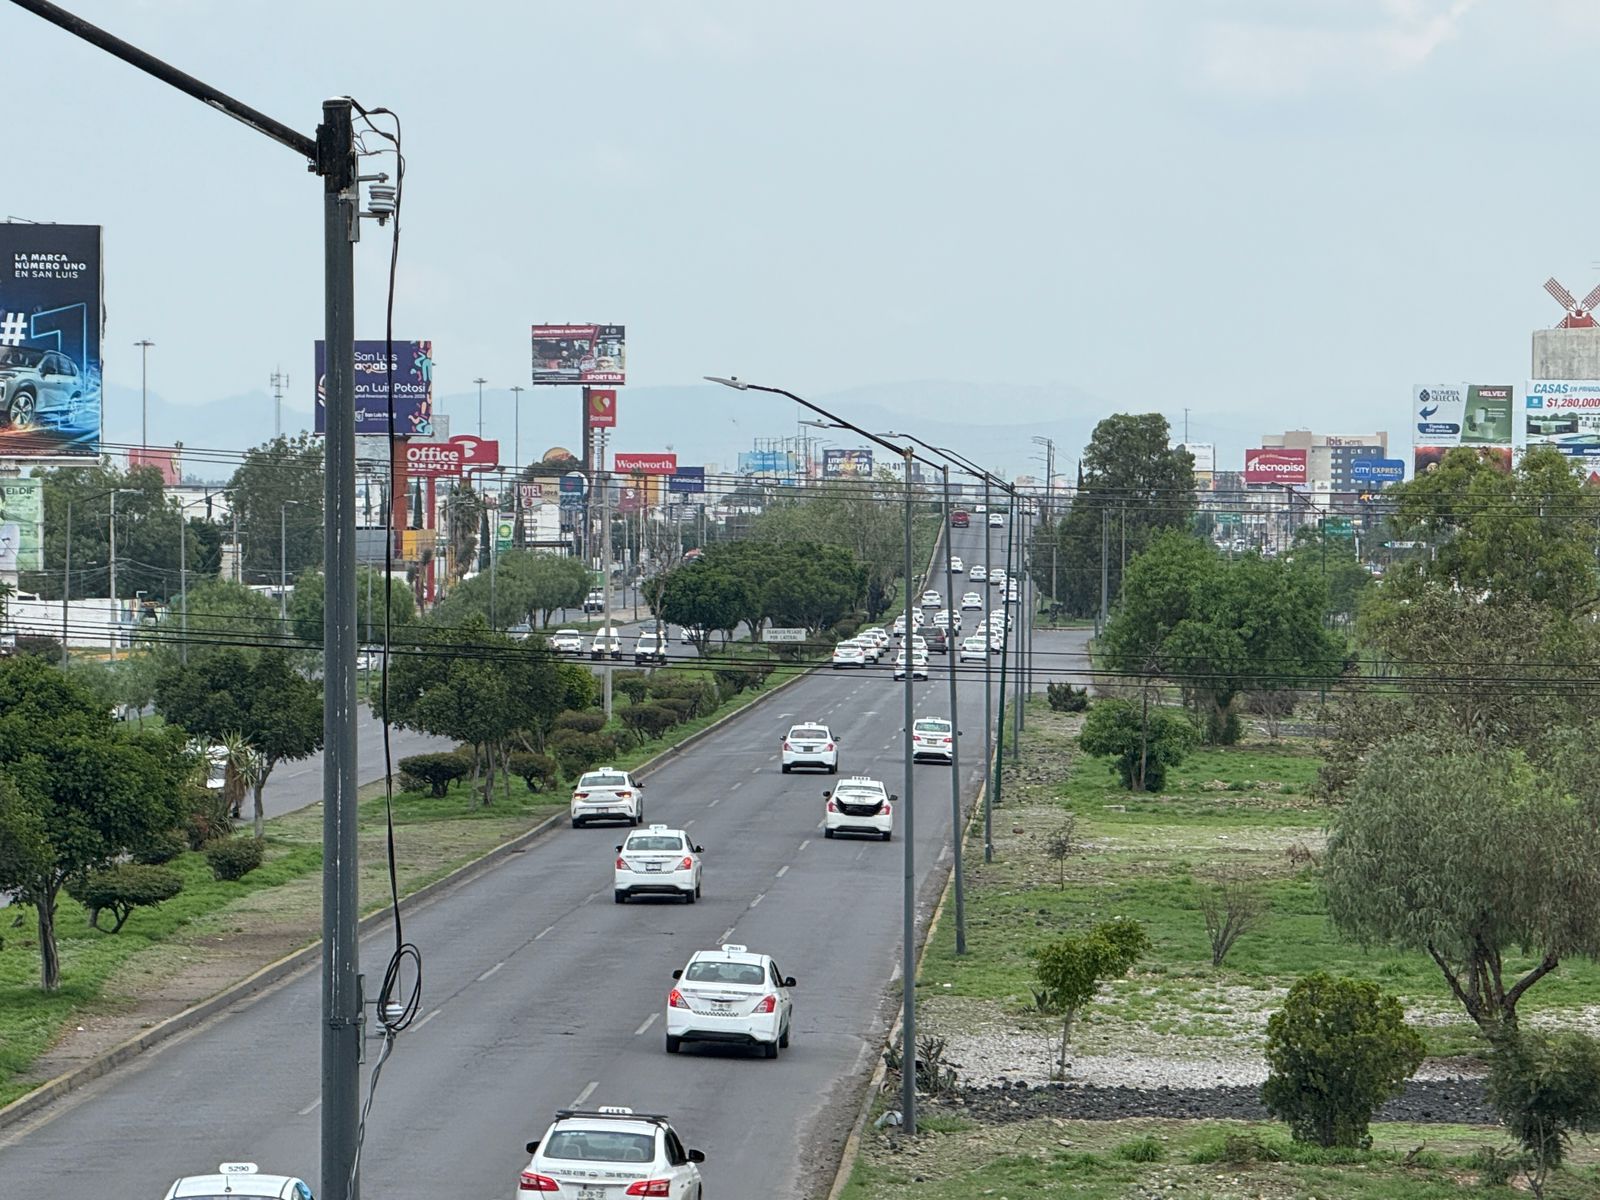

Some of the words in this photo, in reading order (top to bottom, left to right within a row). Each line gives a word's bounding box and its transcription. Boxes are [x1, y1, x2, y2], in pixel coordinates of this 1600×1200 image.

[15, 261, 60, 269] NÚMERO
[354, 352, 375, 361] San
[376, 352, 398, 361] Lus
[1533, 384, 1569, 394] CASAS
[1326, 436, 1343, 446] ibis
[406, 447, 459, 461] Office
[616, 459, 673, 469] Woolworth
[1255, 461, 1306, 474] tecnopiso
[1354, 466, 1370, 474] CITY
[1372, 466, 1403, 474] EXPRESS
